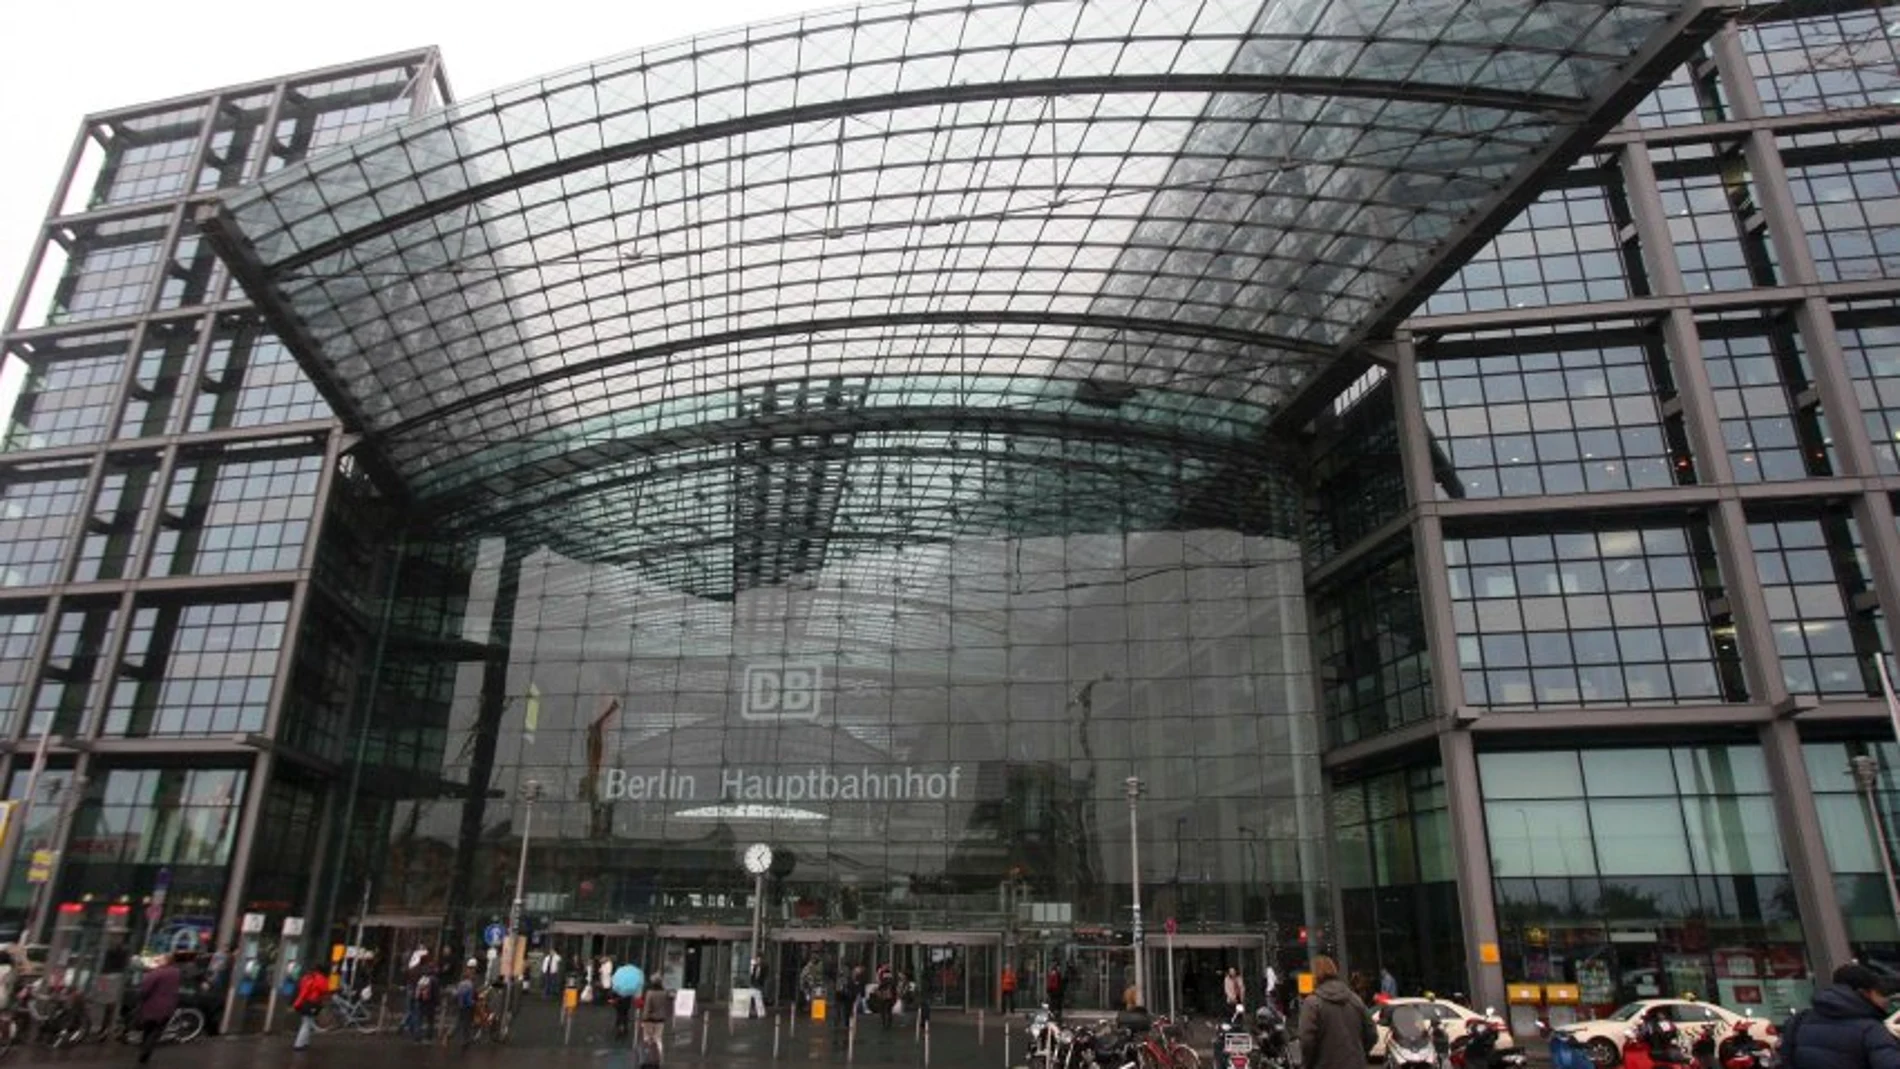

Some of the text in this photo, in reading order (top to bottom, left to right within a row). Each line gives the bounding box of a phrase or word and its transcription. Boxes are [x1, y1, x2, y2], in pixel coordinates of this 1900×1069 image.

[748, 670, 813, 711] DB
[604, 765, 962, 806] Berlin Hauptbahnhof
